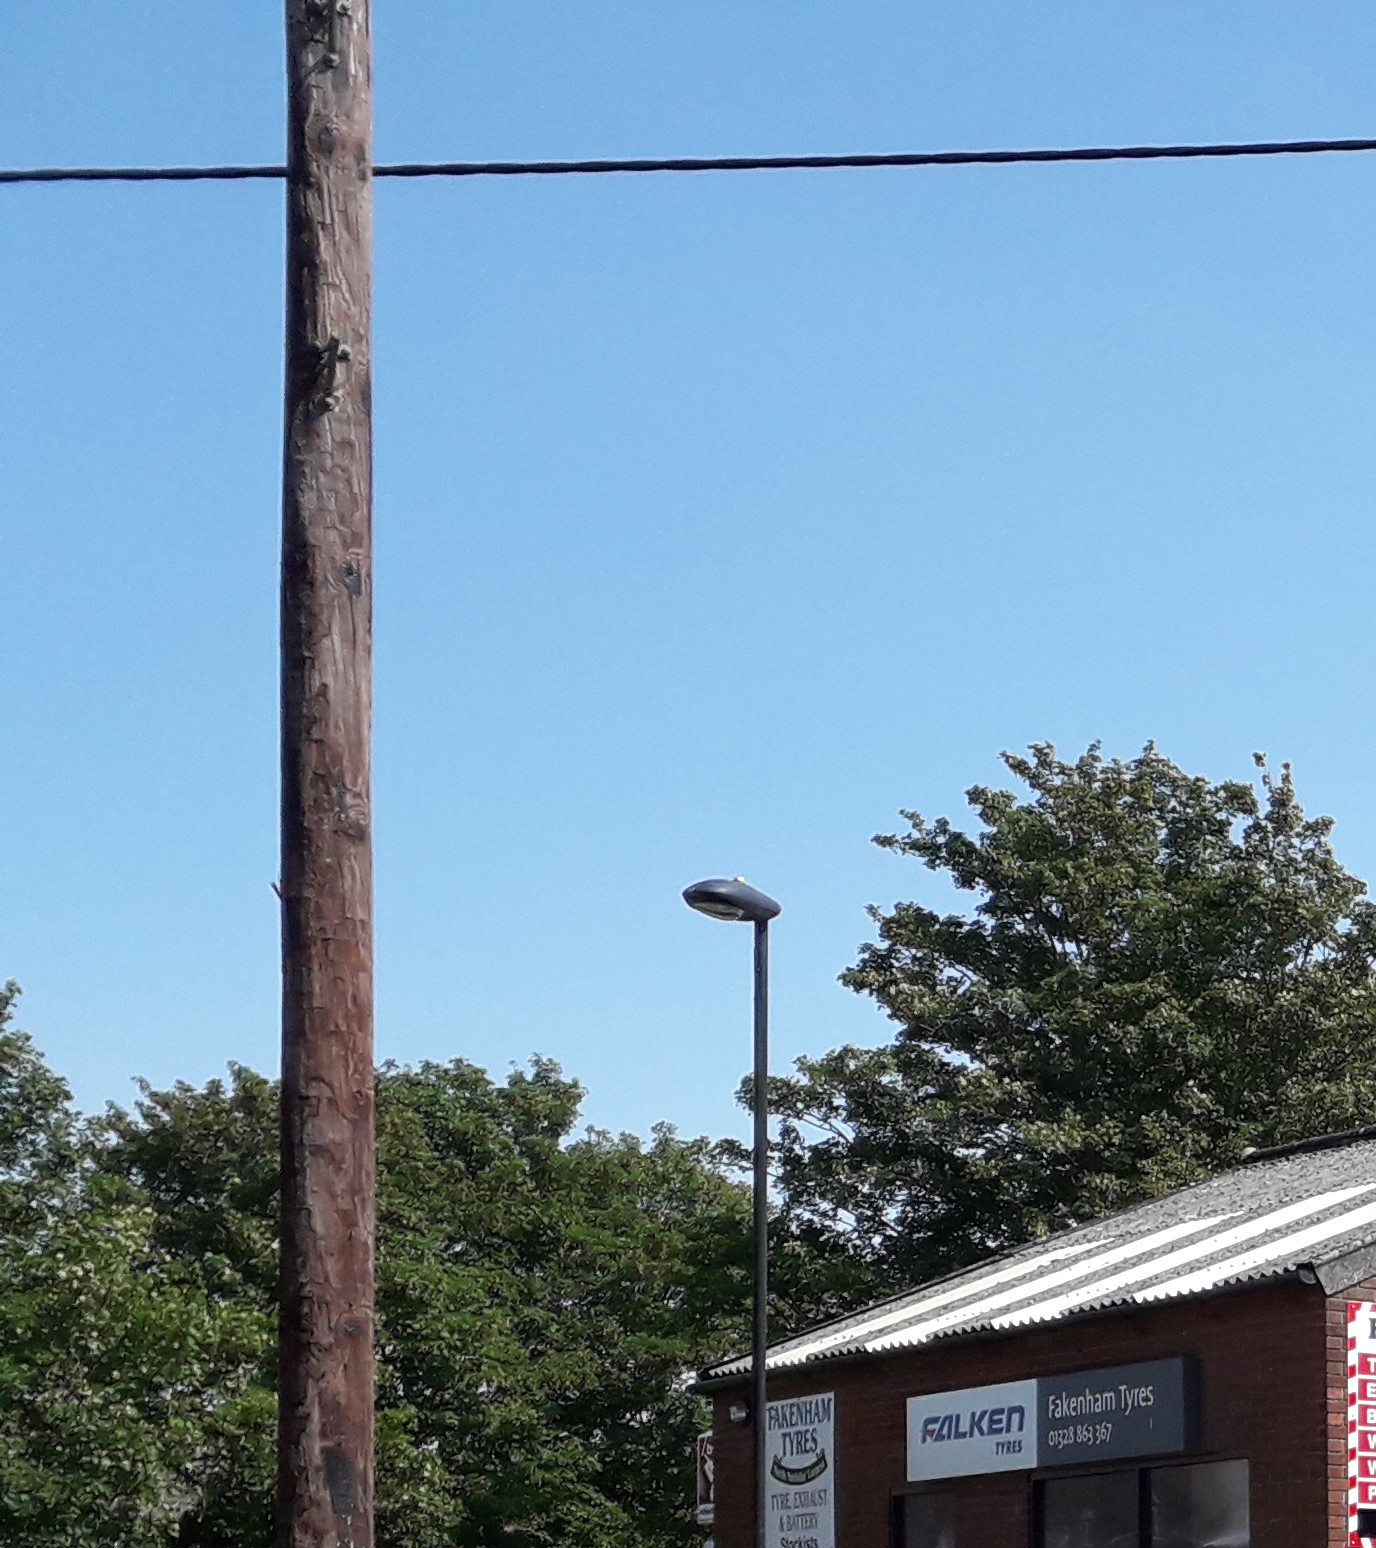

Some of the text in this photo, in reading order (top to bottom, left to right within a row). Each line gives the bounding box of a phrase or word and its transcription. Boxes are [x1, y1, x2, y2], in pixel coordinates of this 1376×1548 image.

[767, 1397, 833, 1432] FAKENHAM
[1048, 1385, 1154, 1419] Fakenham Tyres
[920, 1404, 1026, 1444] FALKEN
[1048, 1421, 1113, 1449] 01328 863 367
[781, 1427, 818, 1457] TYRES
[994, 1441, 1023, 1456] TYRES
